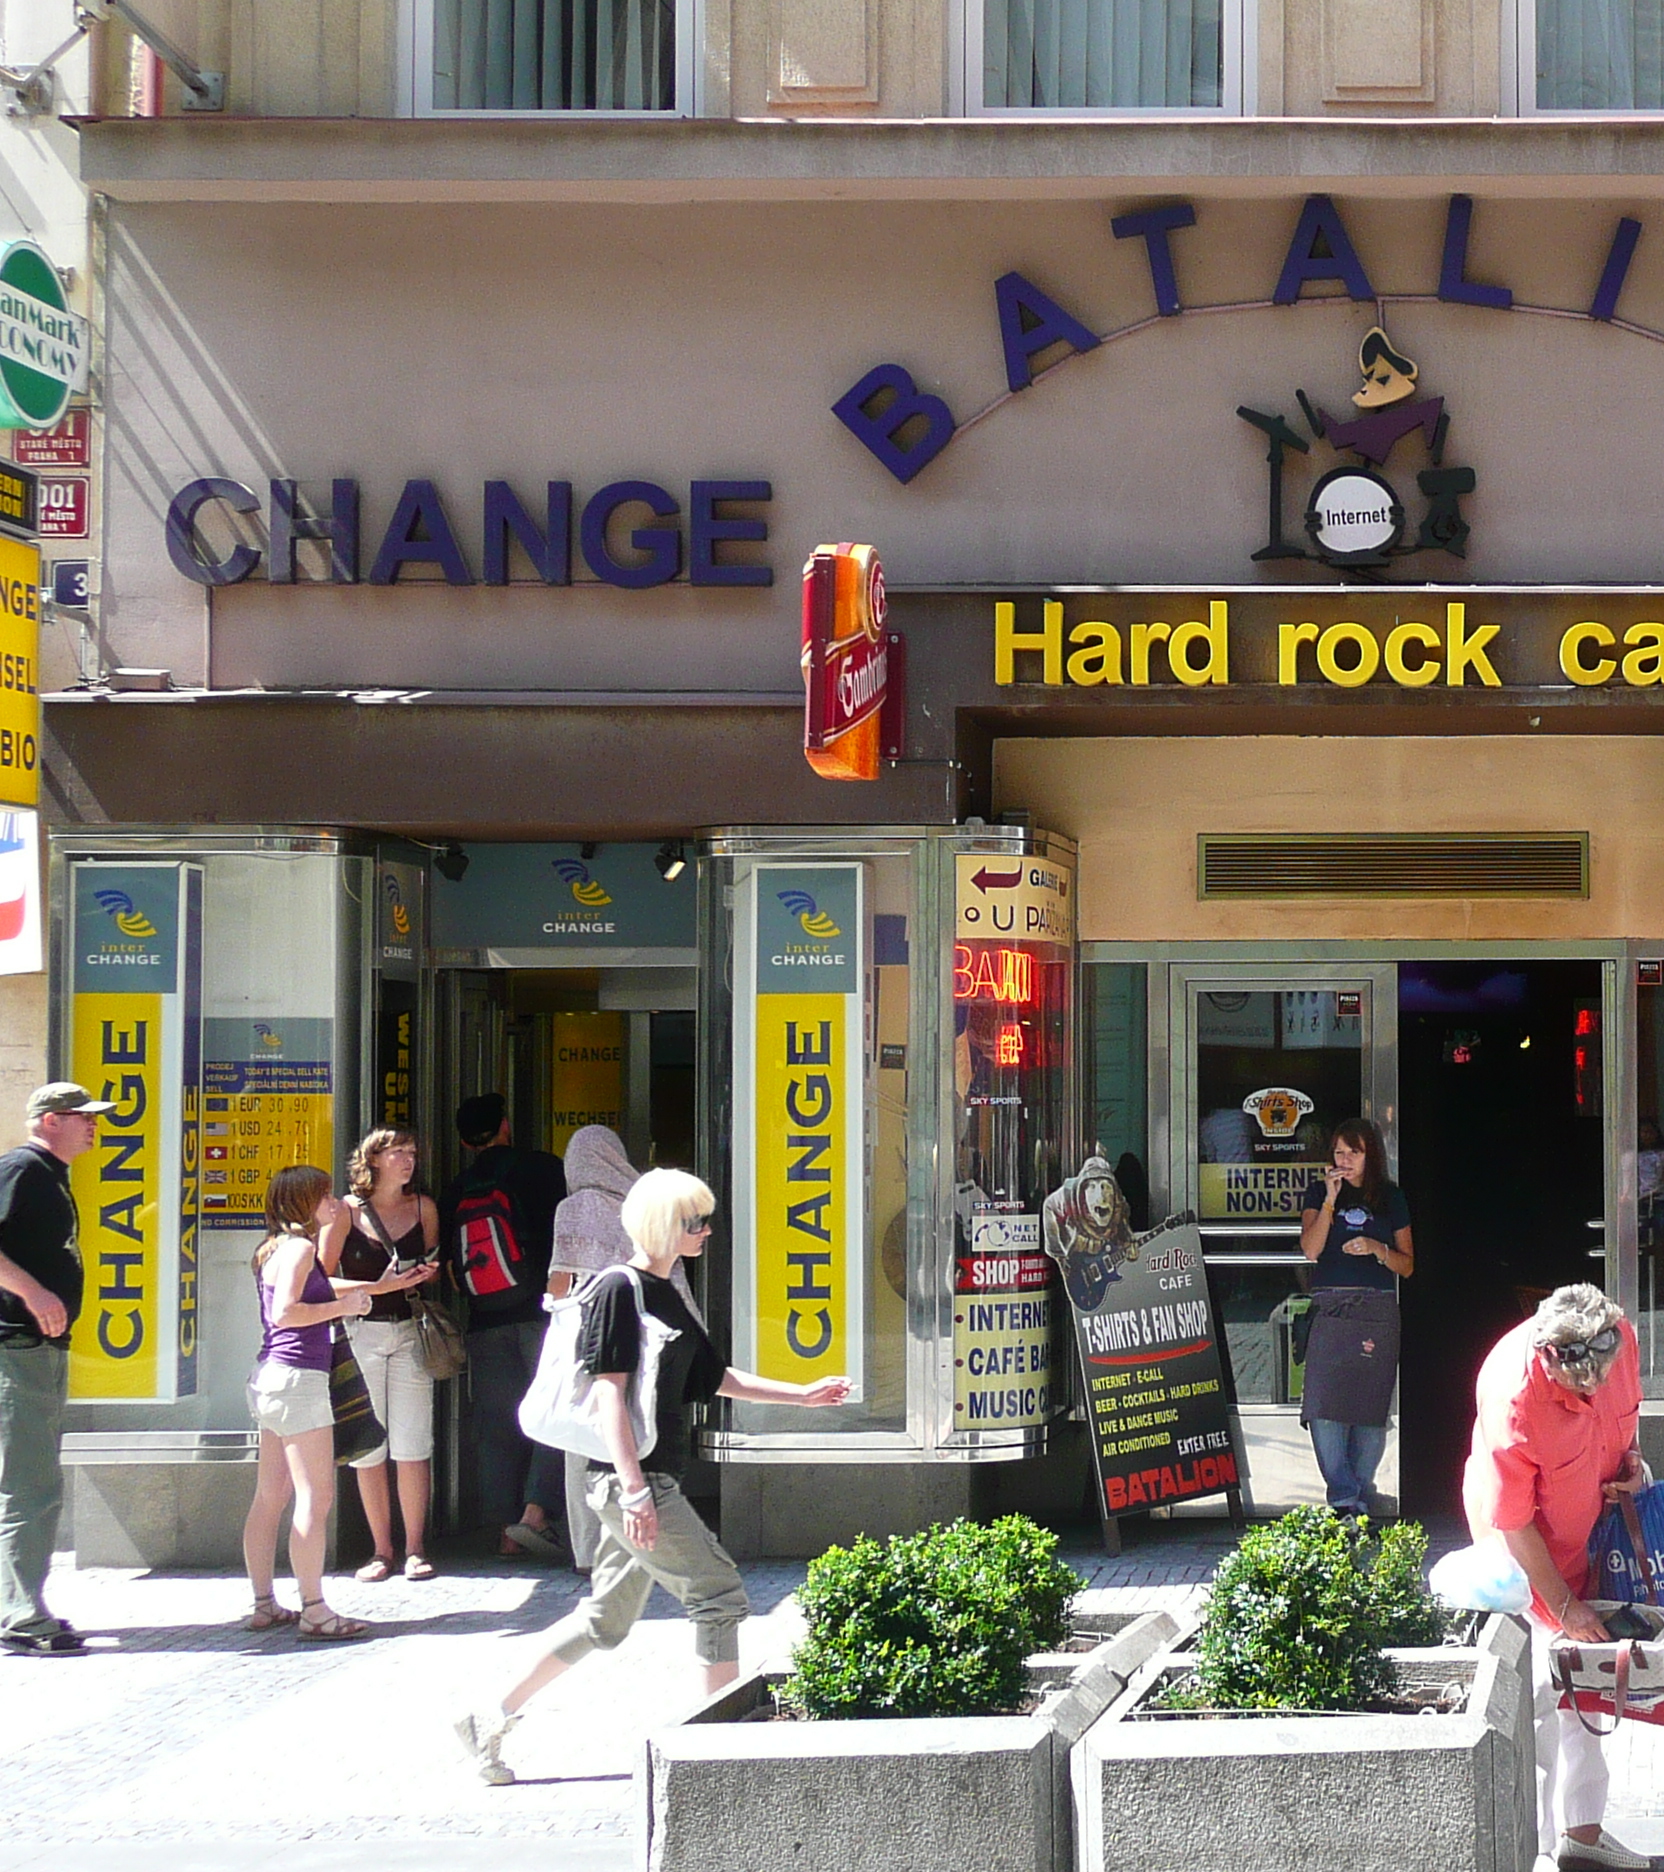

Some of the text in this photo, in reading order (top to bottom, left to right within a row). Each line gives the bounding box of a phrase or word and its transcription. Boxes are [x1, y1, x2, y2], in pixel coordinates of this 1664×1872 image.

[1326, 506, 1387, 526] Internet
[164, 477, 774, 588] CHANGE
[994, 600, 1230, 689] Hard
[1278, 601, 1502, 689] rock
[557, 909, 602, 920] inter
[992, 904, 1014, 931] U
[542, 922, 616, 933] CHANGE
[100, 941, 147, 952] inter
[383, 946, 413, 960] CHANGE
[785, 941, 831, 953] inter
[87, 953, 161, 966] CHANGE
[771, 954, 846, 966] CHANGE
[558, 1047, 620, 1061] CHANGE
[240, 1097, 261, 1112] EUR
[970, 1096, 1022, 1105] SKY SPORTS
[239, 1121, 261, 1136] USD
[239, 1145, 260, 1160] CHF
[1254, 1143, 1306, 1151] SKY SPORTS
[238, 1169, 260, 1184] GBP
[97, 1019, 148, 1359] CHANGE
[786, 1019, 832, 1359] CHANGE
[241, 1194, 264, 1209] SKK
[973, 1200, 1025, 1210] SKY SPORTS
[180, 1085, 198, 1358] CHANGE
[1013, 1224, 1038, 1232] NET
[1011, 1233, 1038, 1243] CALL
[972, 1259, 1020, 1286] SHOP
[1159, 1274, 1193, 1291] CAFE
[1081, 1300, 1208, 1354] T-SHIRTS & FAN SHOP
[968, 1338, 1026, 1376] CAFÉ
[1091, 1367, 1164, 1392] INTERNET E-CALL
[968, 1387, 1035, 1419] MUSIC
[1095, 1379, 1220, 1414] BEER COCKTAILS HARD DRINKS
[1098, 1408, 1179, 1435] LIVE & DANCE MUSIC
[1102, 1431, 1171, 1458] AIR CONDITIONED
[1176, 1430, 1230, 1456] ENTER FREE
[1104, 1452, 1238, 1510] BATALION
